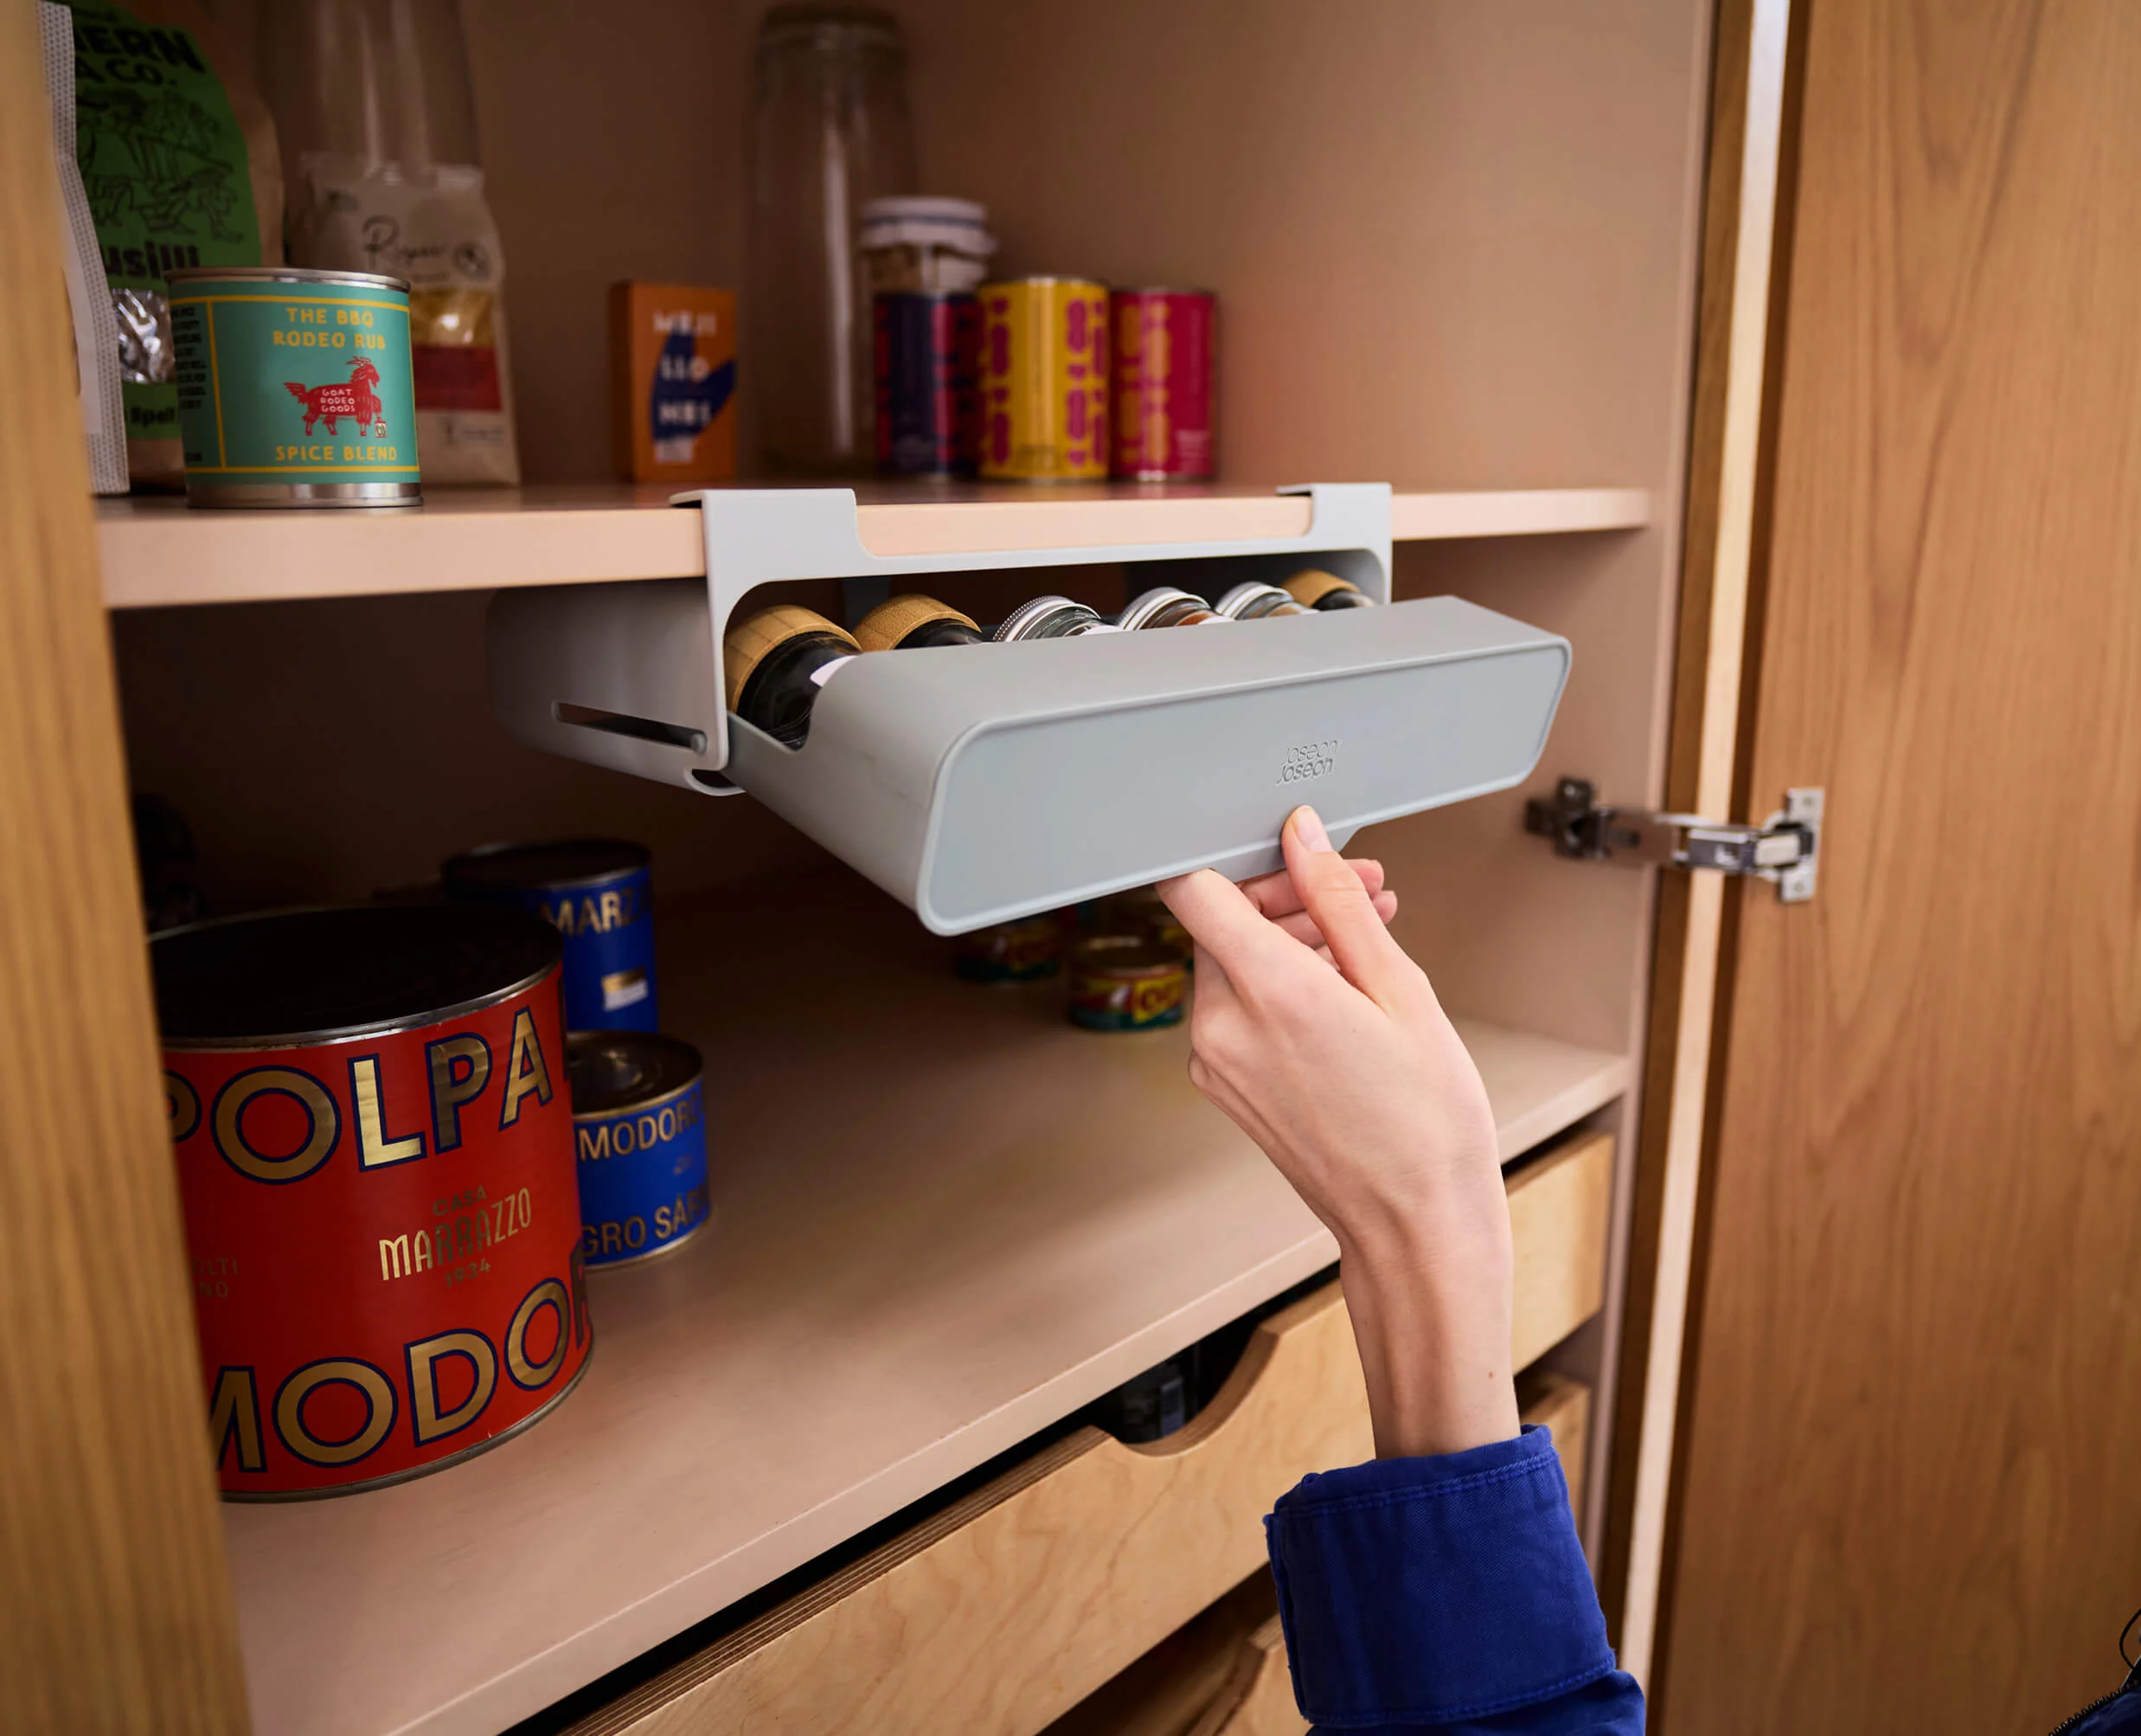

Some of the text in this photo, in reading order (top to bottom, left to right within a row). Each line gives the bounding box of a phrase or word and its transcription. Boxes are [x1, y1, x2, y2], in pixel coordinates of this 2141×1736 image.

[285, 307, 375, 329] THE BBQ
[272, 330, 386, 350] RODEO RUB
[275, 445, 397, 461] SPICE BLEND
[433, 1185, 487, 1216] CASA
[379, 1188, 532, 1281] MARRAZZO
[445, 1258, 491, 1287] 1934
